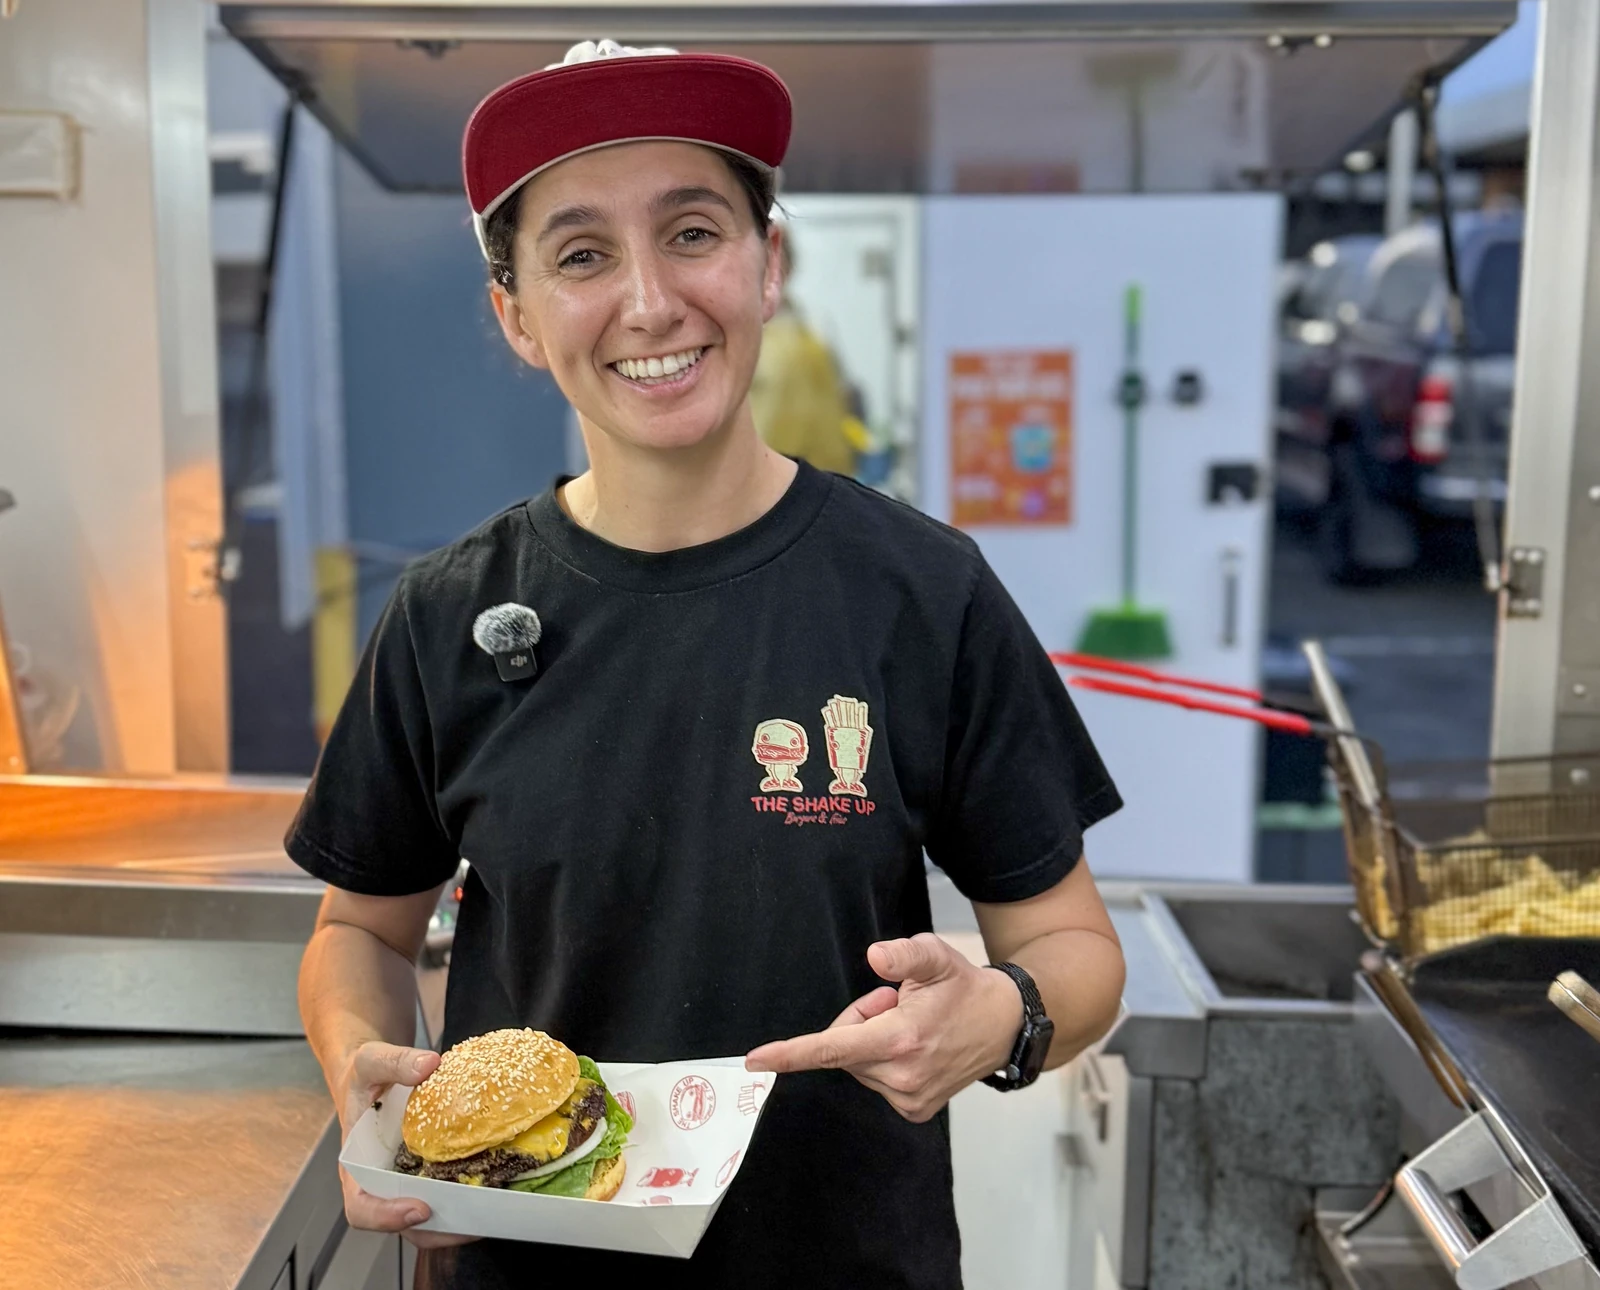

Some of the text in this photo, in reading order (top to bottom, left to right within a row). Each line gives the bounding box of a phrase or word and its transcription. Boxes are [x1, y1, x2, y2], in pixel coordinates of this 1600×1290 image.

[751, 796, 876, 816] THE SHAKE UP
[818, 811, 828, 824] &
[672, 1076, 694, 1129] THE SHAKE UP
